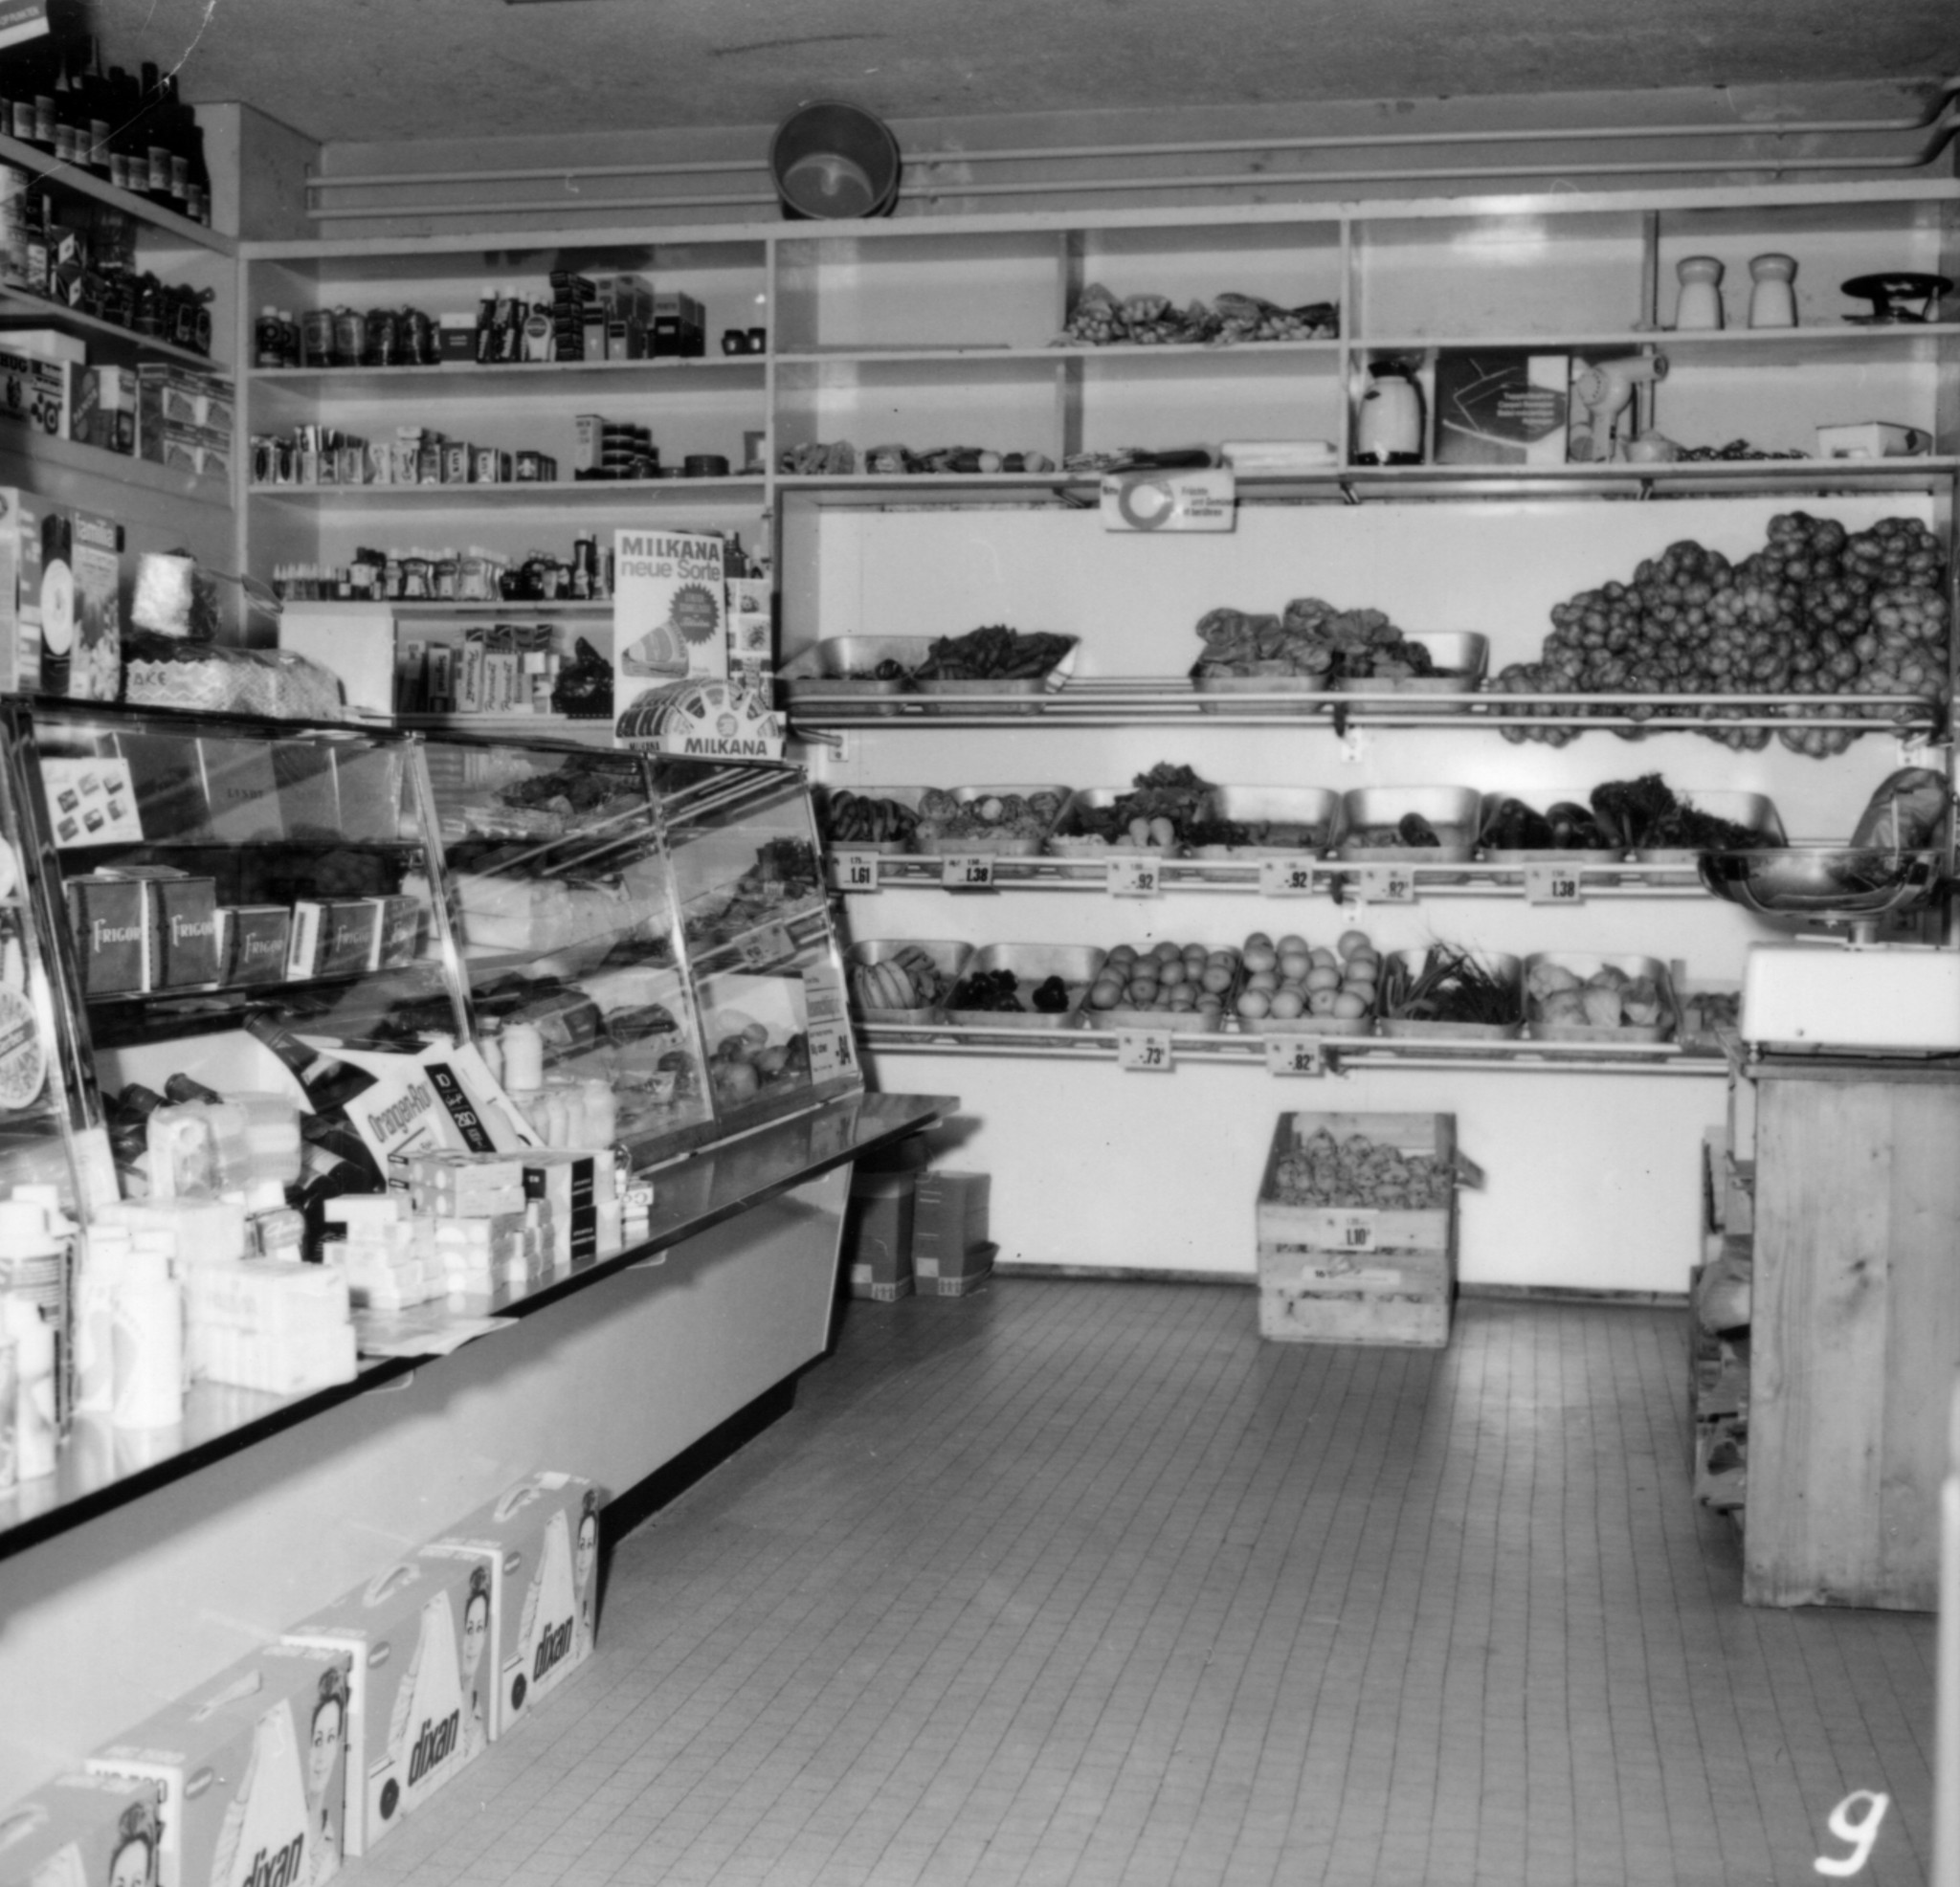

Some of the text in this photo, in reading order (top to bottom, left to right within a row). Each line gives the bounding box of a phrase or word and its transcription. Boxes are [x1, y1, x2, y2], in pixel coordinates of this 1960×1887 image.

[621, 536, 721, 563] MILKANA
[621, 558, 721, 582] neue Sorte
[684, 738, 768, 756] MILKANA
[851, 867, 870, 884] 1.61
[966, 867, 989, 882] 1.38
[1552, 880, 1575, 898] 1.38
[434, 1073, 451, 1087] 10
[532, 1614, 574, 1683] dixan
[408, 1707, 459, 1787] dixan
